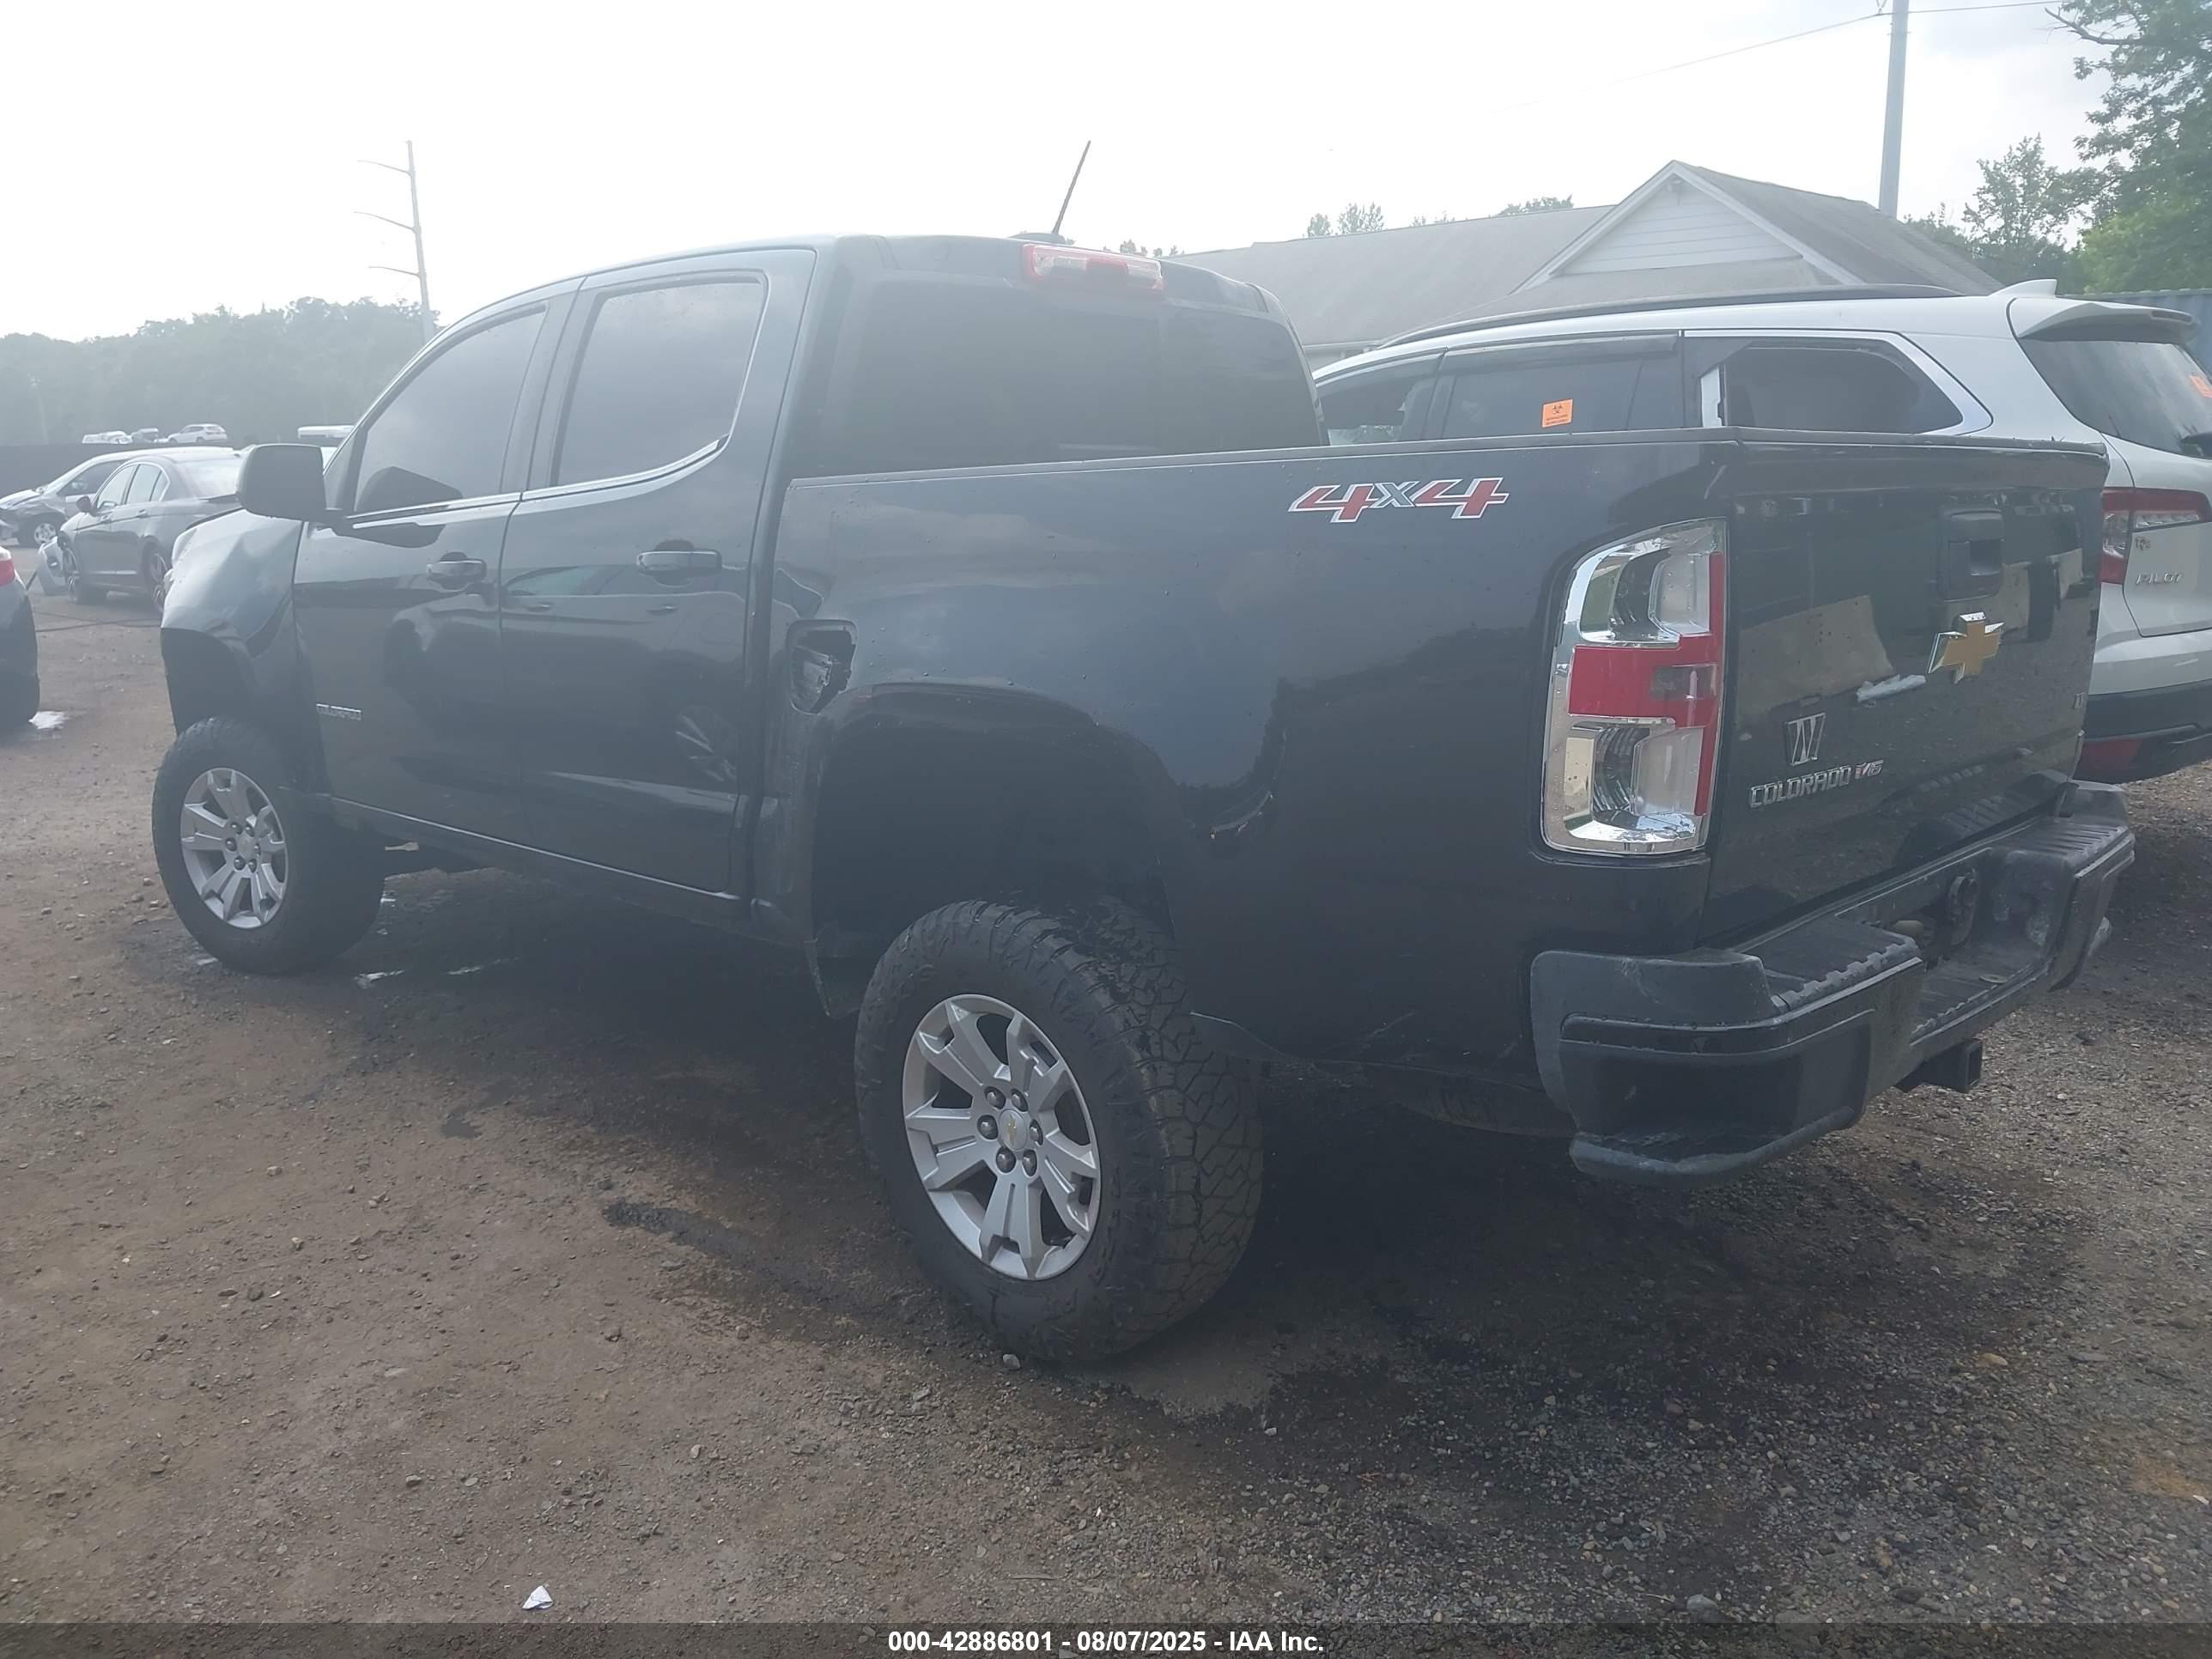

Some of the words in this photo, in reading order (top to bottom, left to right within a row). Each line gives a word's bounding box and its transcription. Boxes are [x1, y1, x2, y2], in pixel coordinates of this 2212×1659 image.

[2136, 571, 2182, 585] PILOT
[1750, 764, 1851, 808] COLORADO
[1855, 759, 1884, 780] V6
